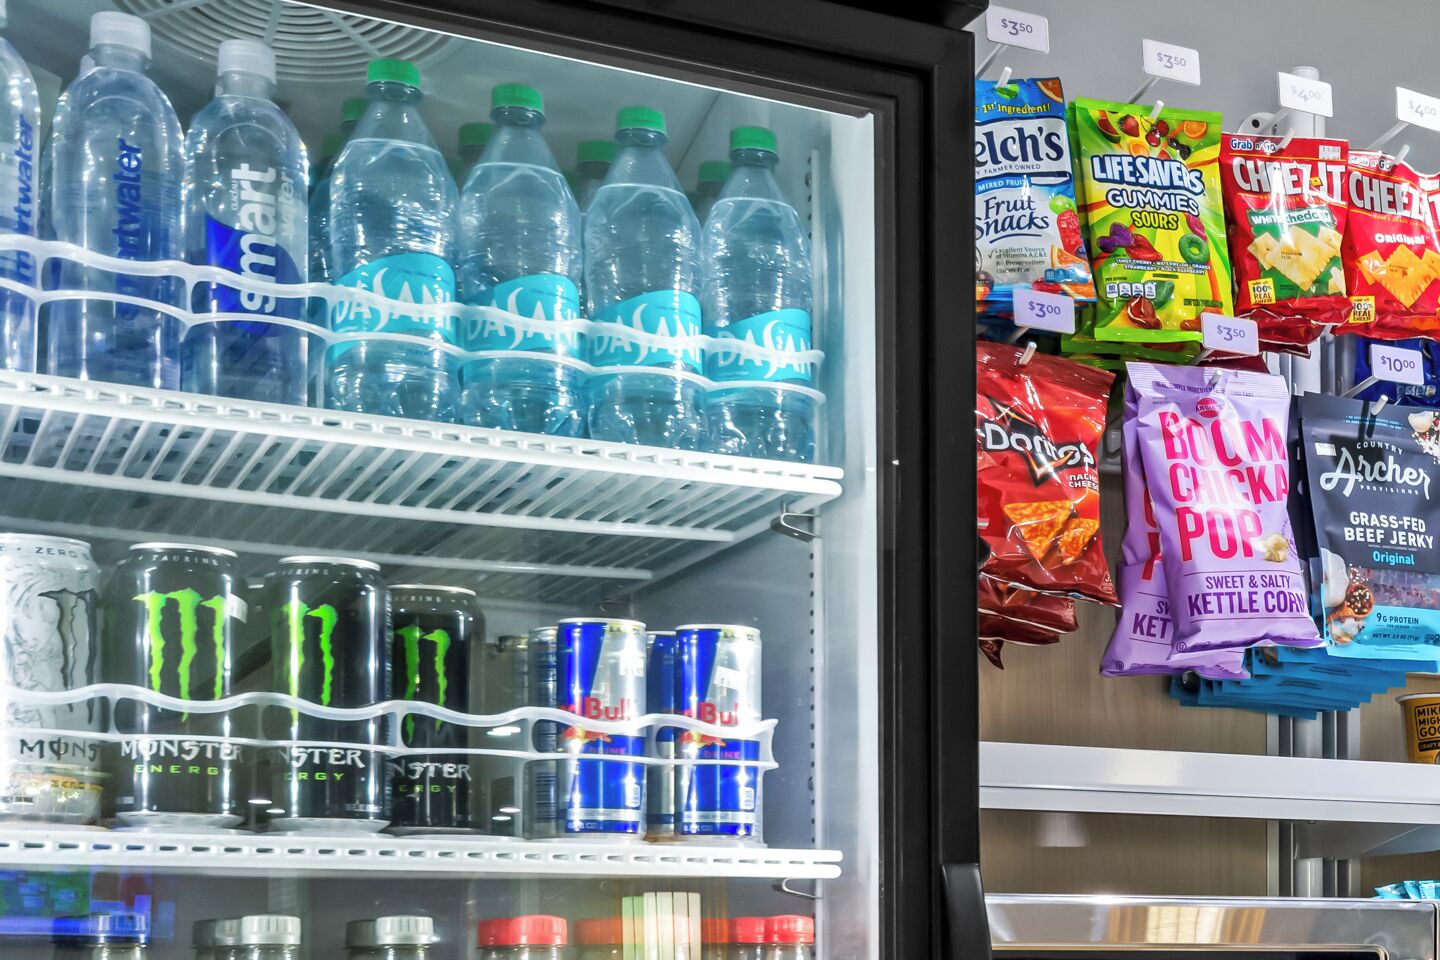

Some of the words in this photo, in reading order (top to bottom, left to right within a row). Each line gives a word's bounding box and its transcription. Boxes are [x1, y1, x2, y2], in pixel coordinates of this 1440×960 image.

[998, 103, 1051, 114] Ingredient!
[976, 127, 1064, 167] elch's
[984, 165, 1012, 174] FARMER
[978, 180, 1004, 191] MIXED
[983, 195, 1036, 220] Fruit
[1107, 189, 1200, 216] GUMMIES
[1131, 211, 1179, 230] SOURS
[1254, 292, 1272, 300] REAL
[984, 422, 1095, 466] Doritos
[1159, 412, 1287, 467] BOOM
[1356, 441, 1403, 455] COUNTRY
[1169, 462, 1289, 505] CHICKA
[1320, 446, 1431, 500] Archer
[1361, 485, 1419, 495] PROVISIONS
[1350, 511, 1426, 532] GRASS-FED
[1176, 506, 1263, 562] POP
[1344, 527, 1385, 543] BEEF
[1390, 531, 1434, 549] JERKY
[1373, 551, 1415, 565] Original
[1206, 576, 1244, 590] SWEET
[1249, 576, 1258, 587] &
[1261, 575, 1291, 589] SALTY
[1188, 591, 1258, 617] KETTLE
[1264, 591, 1304, 613] CORN
[1390, 616, 1419, 625] PROTEIN
